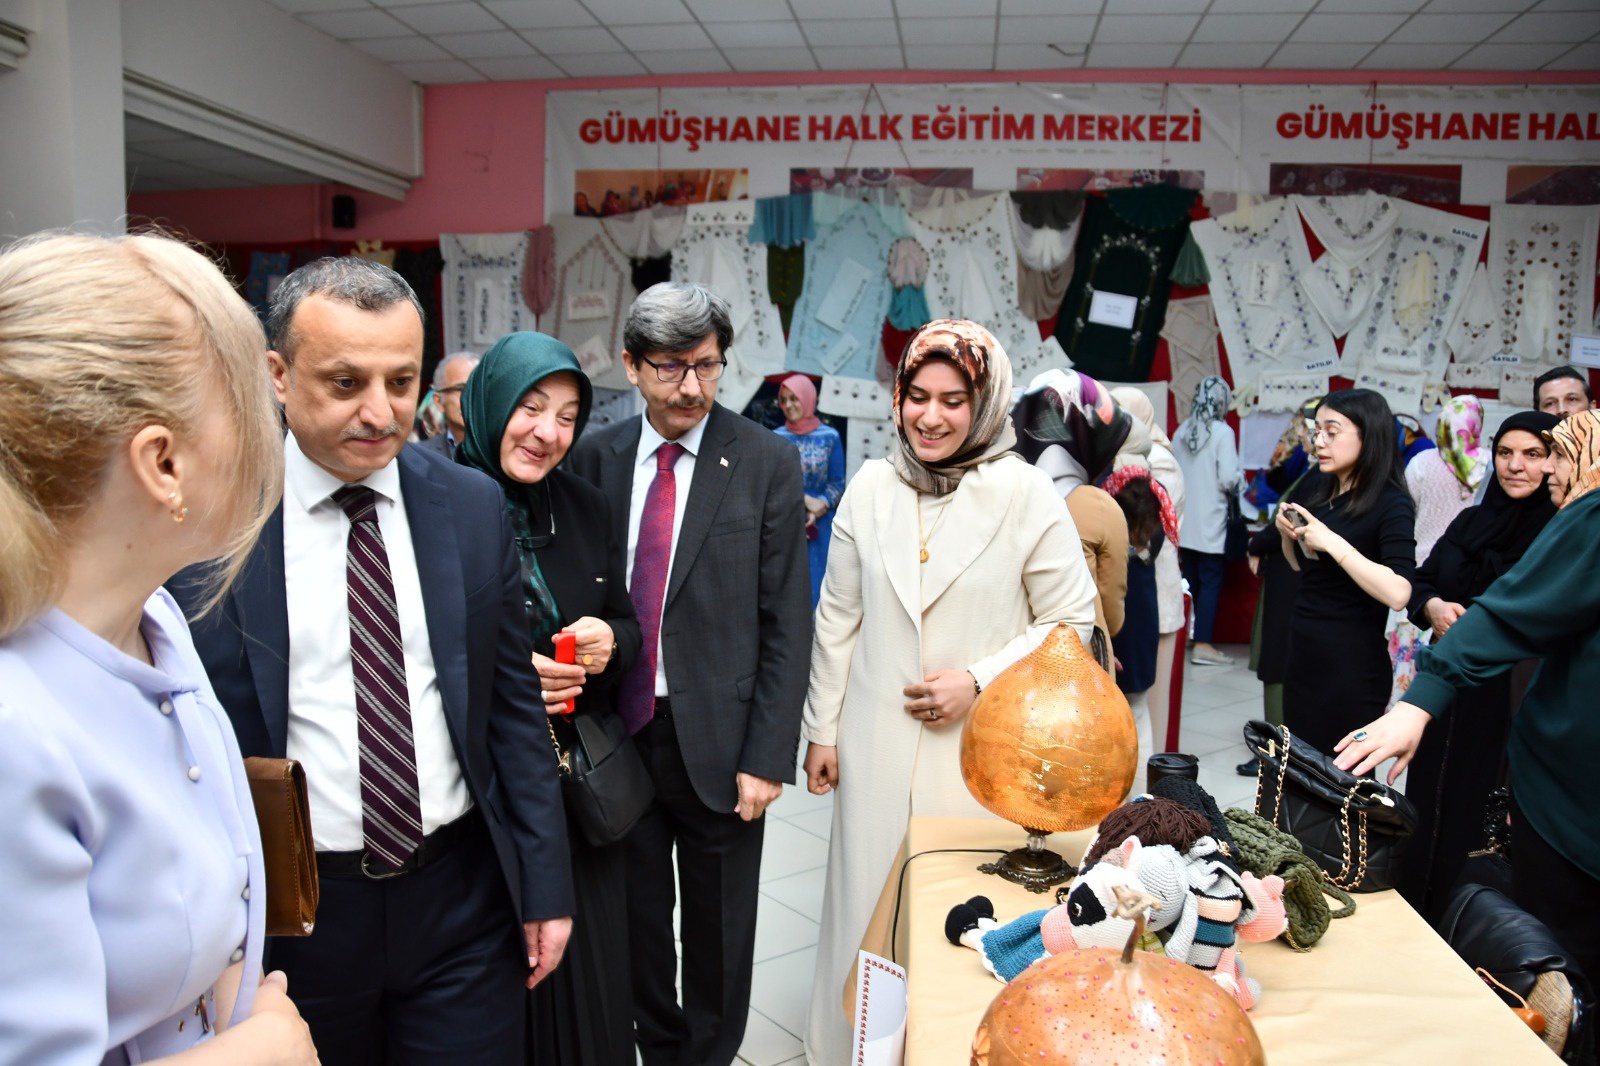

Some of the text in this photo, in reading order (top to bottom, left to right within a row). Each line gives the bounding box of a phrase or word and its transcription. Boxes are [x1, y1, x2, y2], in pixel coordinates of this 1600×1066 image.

[579, 104, 1202, 152] GÜMÜŞHANE HALK EĞİTİM MERKEZİ
[1276, 104, 1520, 150] GÜMÜŞHANE
